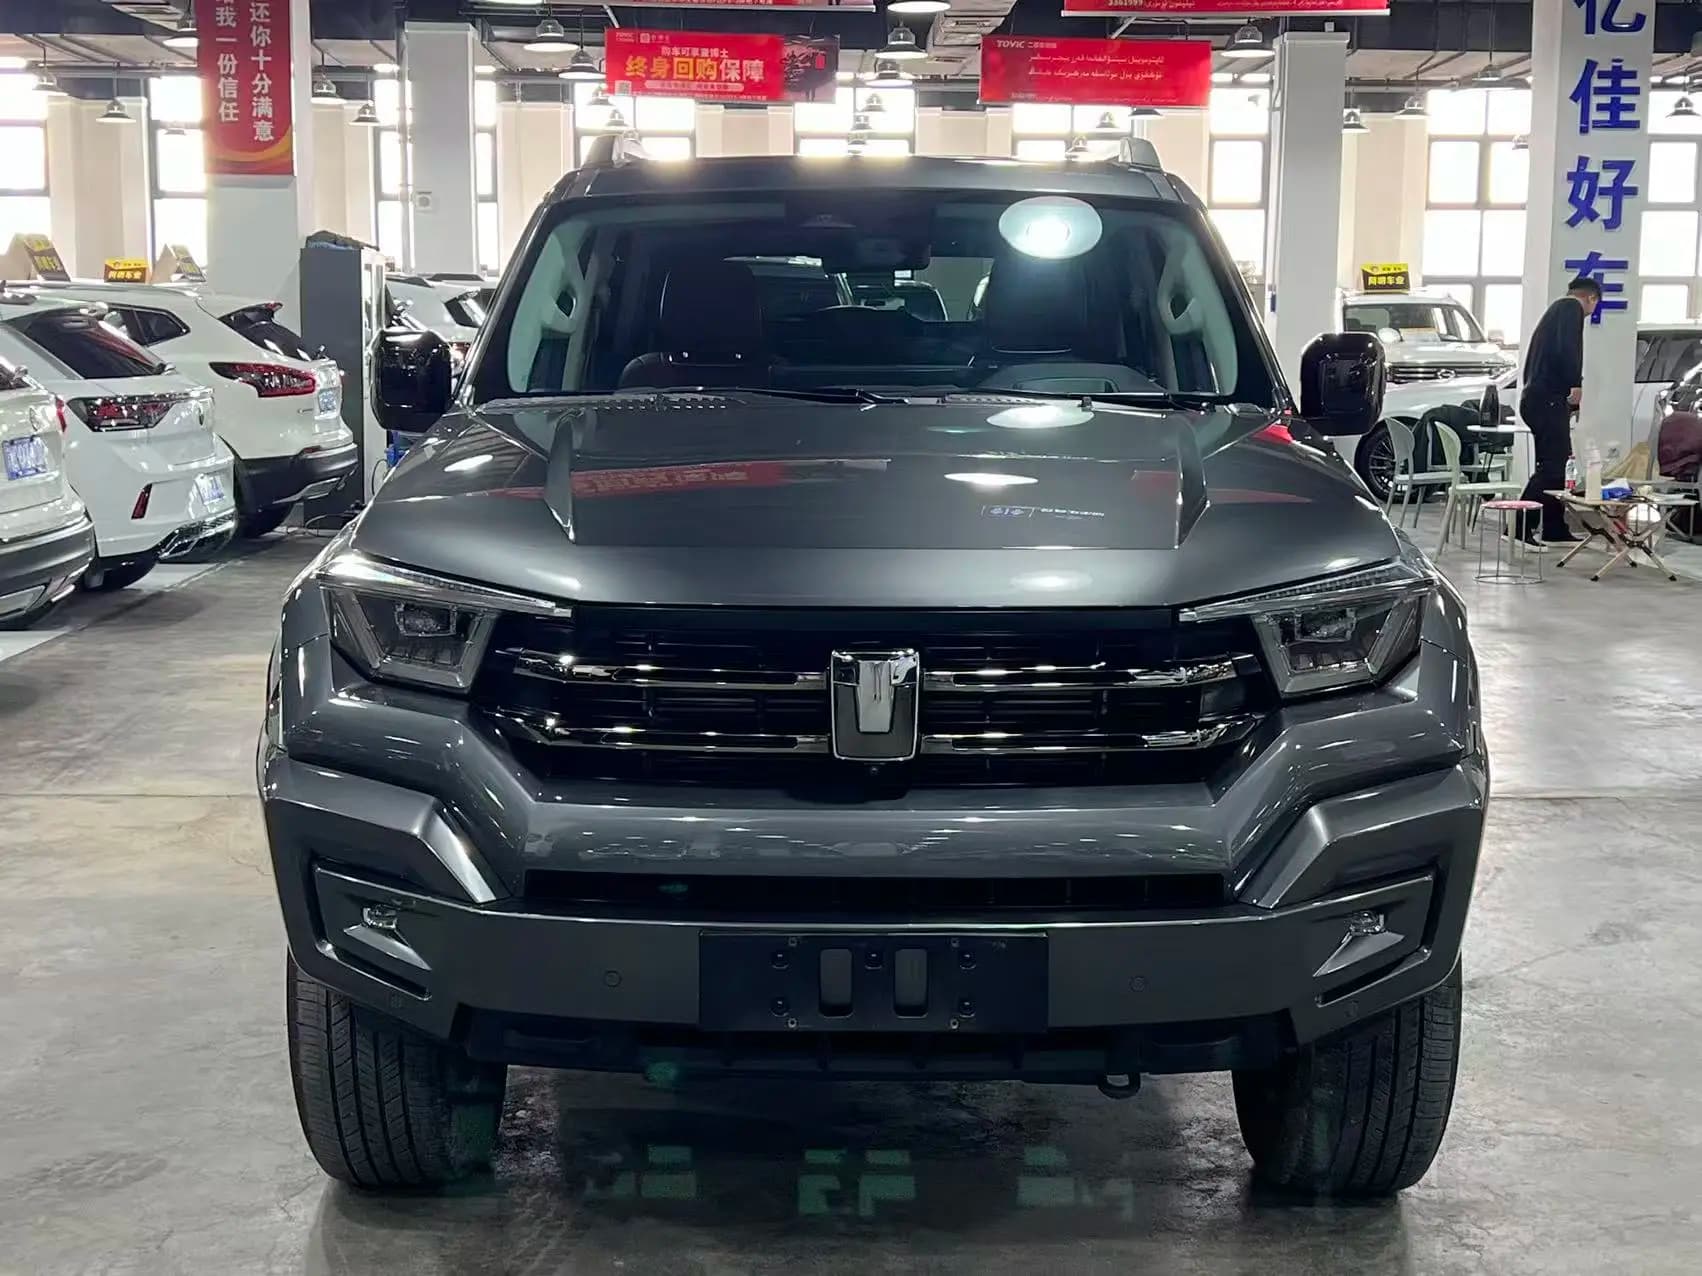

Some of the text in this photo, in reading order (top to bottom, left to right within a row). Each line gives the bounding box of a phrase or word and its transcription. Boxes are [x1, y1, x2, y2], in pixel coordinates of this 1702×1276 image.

[216, 0, 240, 122] 我一份信任
[249, 2, 274, 142] 还你十分满意
[625, 55, 764, 82] 终身回购保障
[997, 40, 1025, 49] TOVIC
